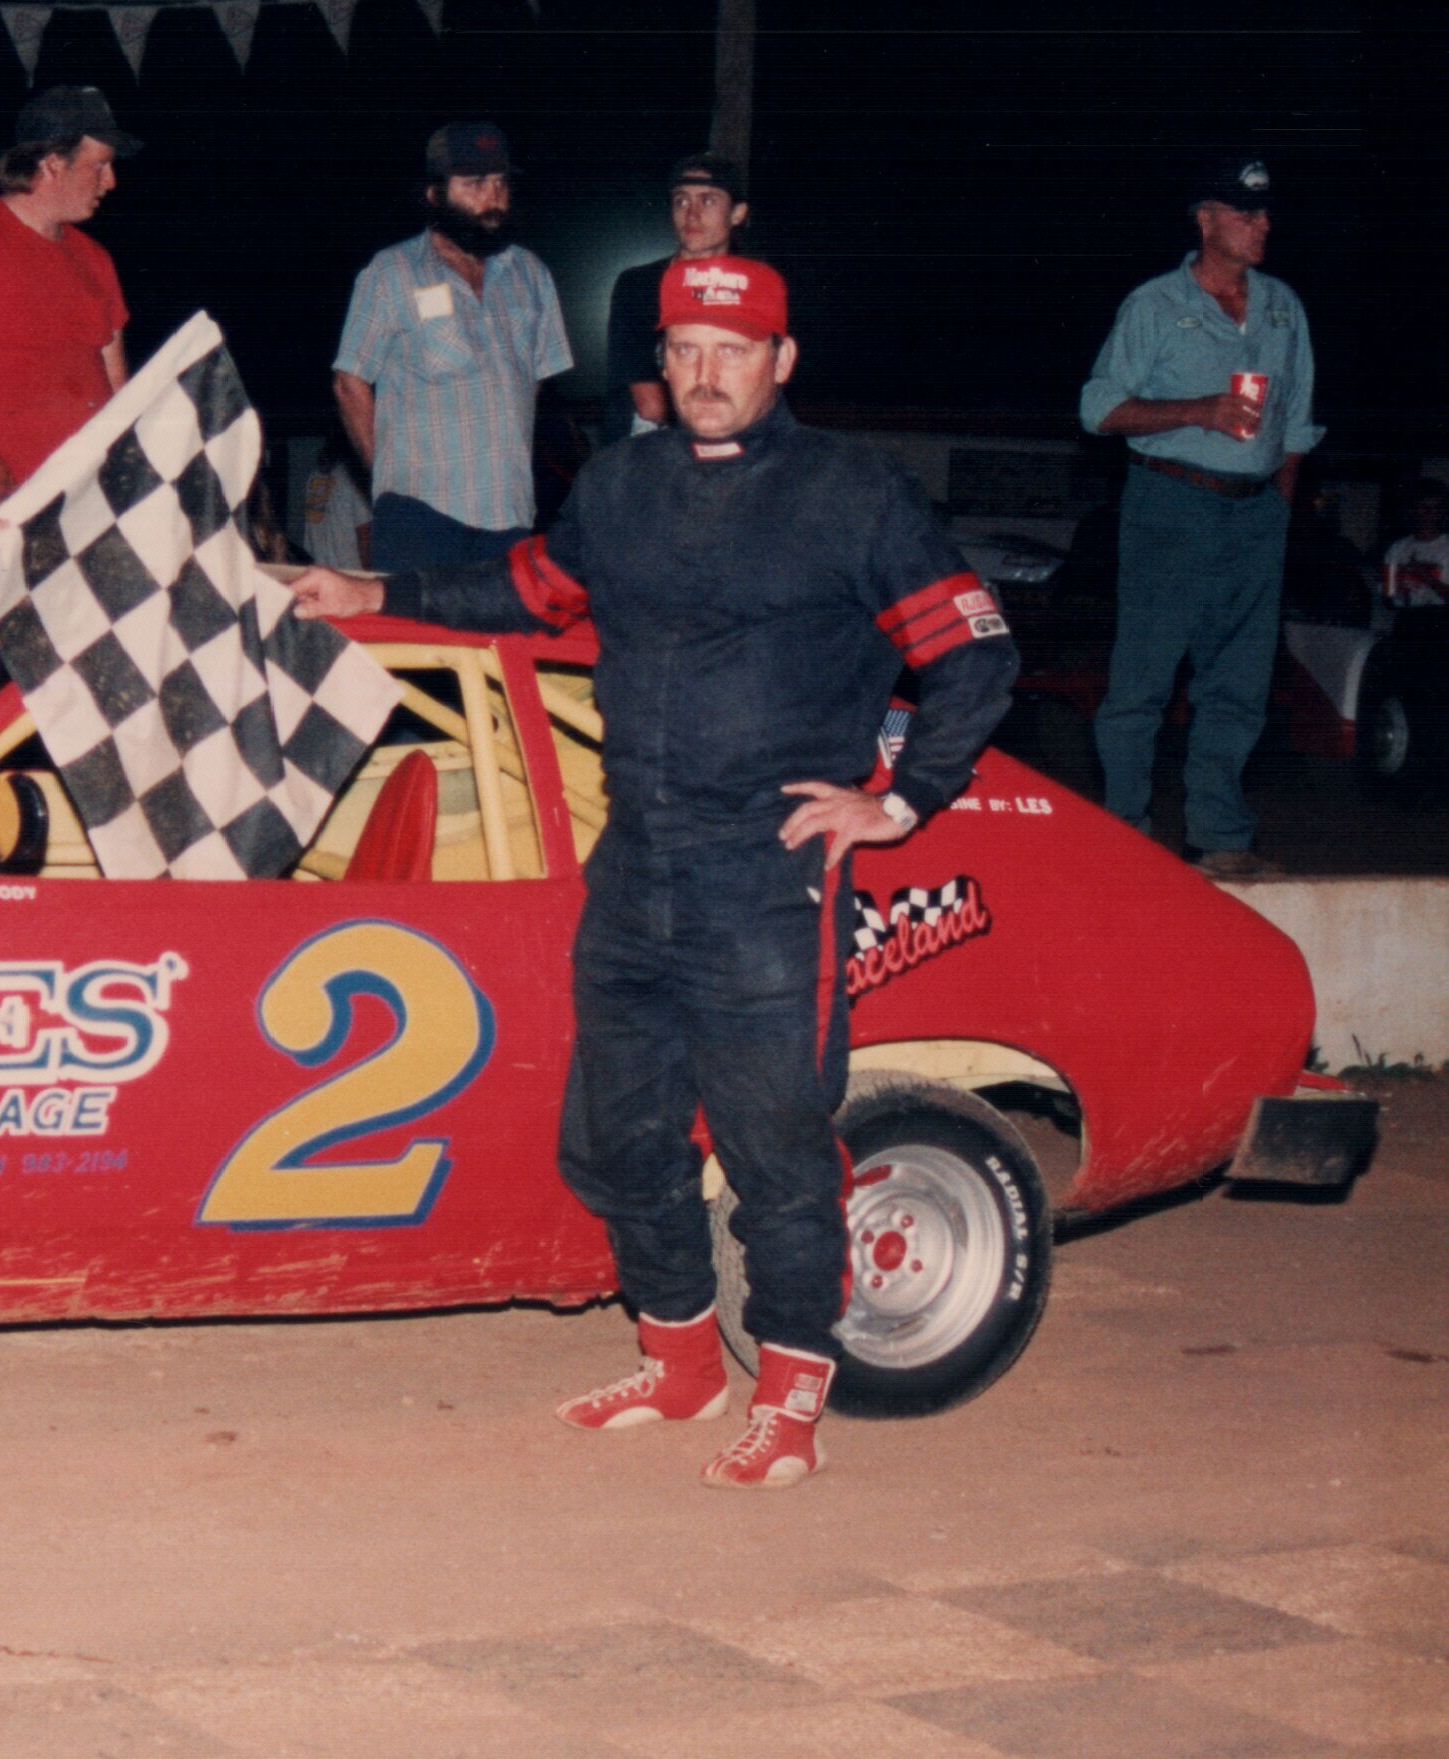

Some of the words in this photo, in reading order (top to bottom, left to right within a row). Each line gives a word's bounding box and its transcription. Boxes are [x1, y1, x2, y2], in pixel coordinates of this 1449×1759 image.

[1015, 797, 1053, 815] LES
[846, 879, 987, 995] aceland
[193, 916, 497, 1233] 2
[985, 1156, 1029, 1241] RADIAL
